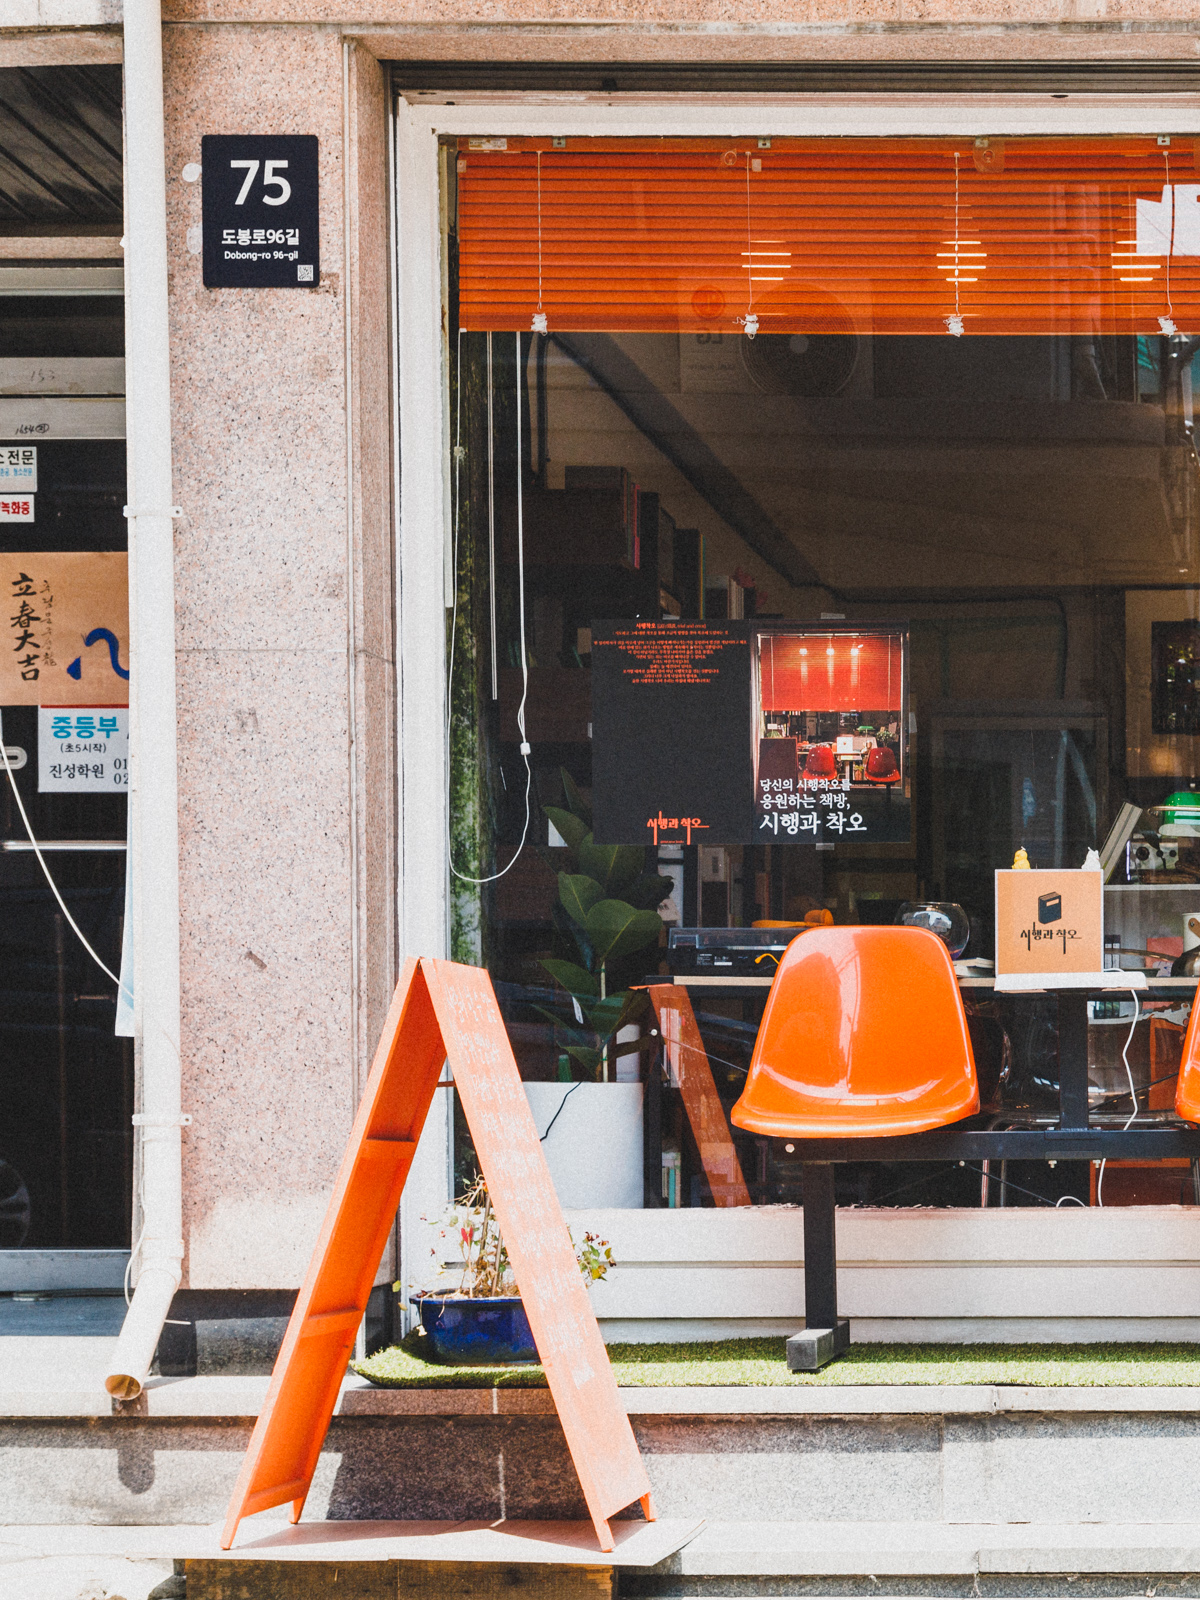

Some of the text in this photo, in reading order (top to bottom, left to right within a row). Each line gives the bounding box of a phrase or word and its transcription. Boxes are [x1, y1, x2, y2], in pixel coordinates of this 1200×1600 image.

[230, 160, 292, 206] 75
[221, 228, 300, 246] 도봉로96길
[224, 251, 299, 261] Dobong-ro 96-gil
[11, 572, 41, 681] 立春大吉
[51, 716, 119, 739] 중등부
[60, 743, 107, 754] (초5시작)
[49, 763, 105, 779] 진성학원
[760, 778, 852, 791] 당신의 시행착오를
[760, 792, 851, 810] 응원하는 책방,
[759, 811, 868, 836] 시행과 착오
[1020, 922, 1082, 954] 시행과 착오
